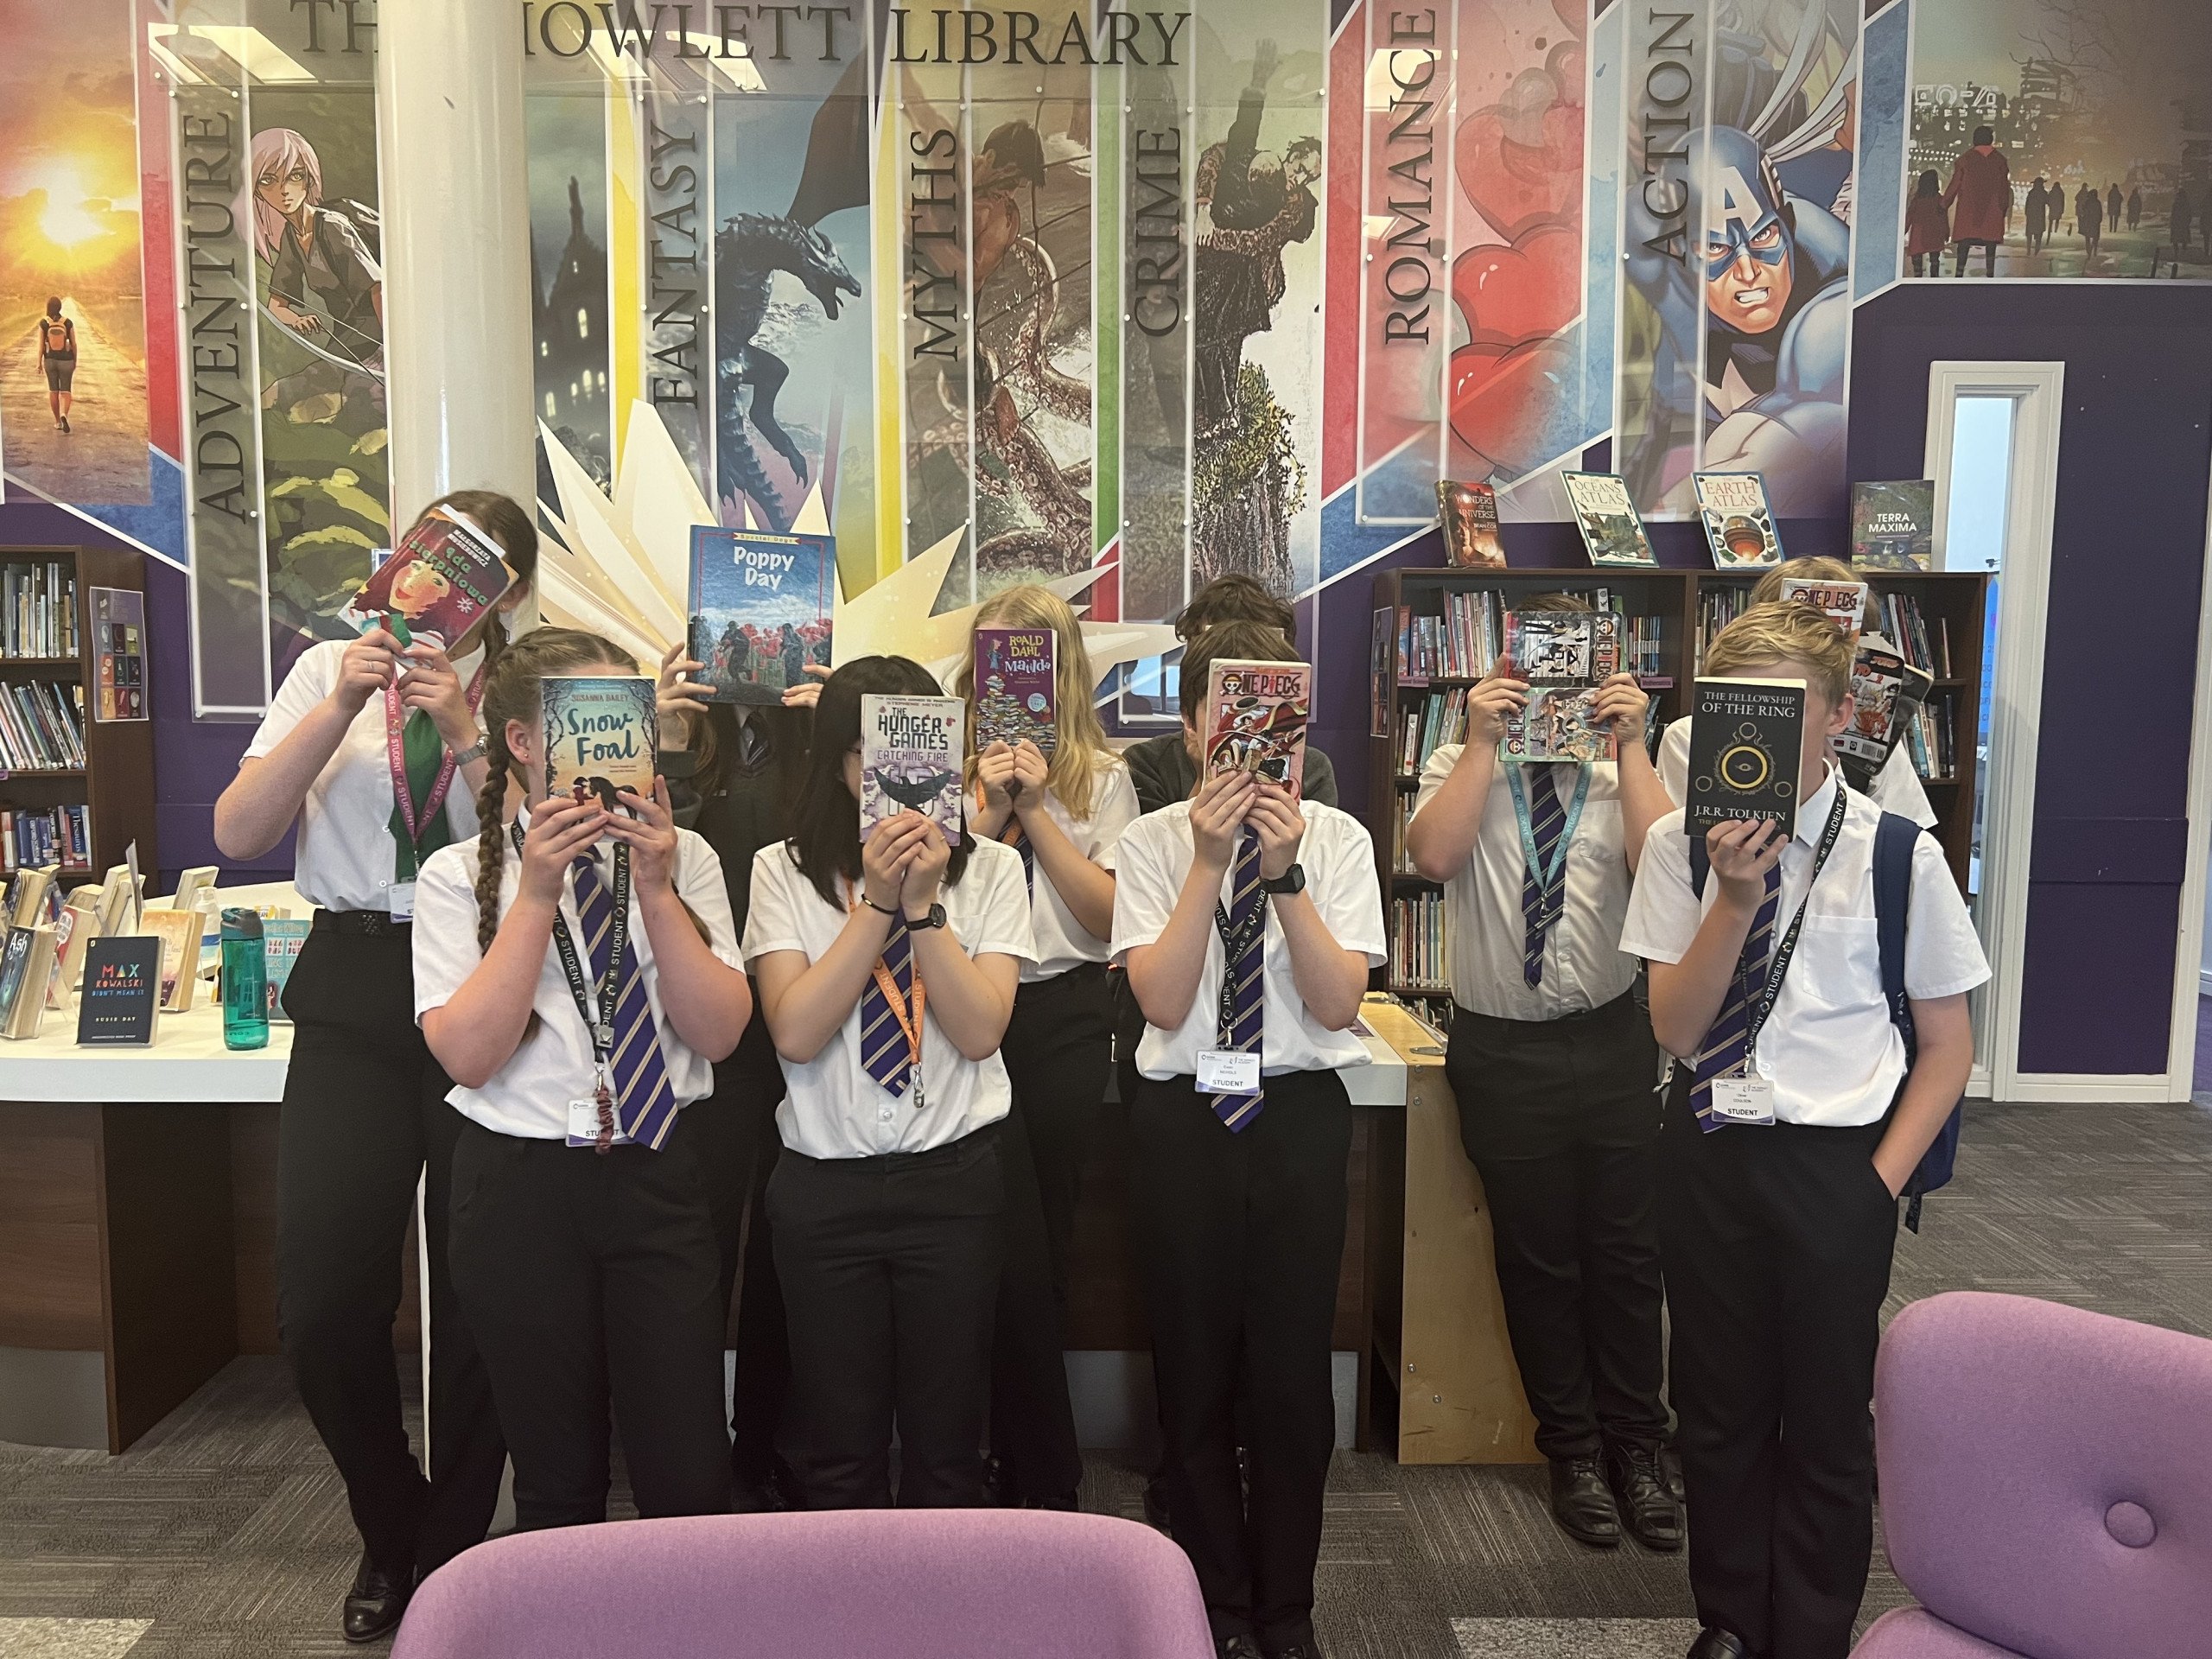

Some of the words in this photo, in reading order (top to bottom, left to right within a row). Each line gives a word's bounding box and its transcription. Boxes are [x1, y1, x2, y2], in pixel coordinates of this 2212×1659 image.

[290, 0, 378, 54] TH
[523, 0, 851, 61] OWLETT
[890, 7, 1192, 67] LIBRARY
[1641, 7, 1695, 268] ACTION
[1385, 8, 1438, 346] ROMANCE
[910, 129, 959, 363] MYTHS
[1134, 127, 1182, 339] CRIME
[650, 122, 699, 409] FANTASY
[182, 110, 246, 520] ADVENTURE
[1455, 493, 1493, 505] WONDERS
[1575, 481, 1621, 493] OCEANS
[1580, 491, 1625, 505] ATLAS
[1705, 482, 1756, 494] EARTH
[1713, 493, 1758, 506] ATLAS
[1459, 508, 1496, 519] UNIVERSE
[1877, 512, 1910, 523] TERRA
[1868, 522, 1917, 533] MAXIMA
[734, 546, 795, 572] Poppy
[745, 567, 783, 593] Day
[1824, 590, 1859, 611] PECE
[1008, 635, 1045, 646] ROALD
[1011, 646, 1041, 658] DAHL
[1004, 658, 1052, 674] Matilda
[571, 694, 605, 702] SUSANNA
[606, 694, 630, 702] BAILEY
[1701, 702, 1722, 713] OF
[1725, 703, 1755, 715] THE
[1758, 706, 1796, 718] RING
[1705, 691, 1726, 701] THE
[1728, 692, 1796, 705] FELLOWSHIP
[567, 708, 633, 735] Snow
[892, 707, 907, 718] THE
[391, 739, 402, 772] STUDENT
[576, 729, 640, 766] Foal
[877, 750, 924, 761] CATCHING
[927, 751, 949, 762] FIRE
[435, 760, 454, 798] STUDENT
[398, 787, 415, 826] STUDENT
[1516, 803, 1530, 836] STUDENT
[1567, 802, 1582, 833] STUDENT
[1727, 808, 1786, 821] TOLKIEN
[73, 815, 81, 853] Thesaurus
[1826, 802, 1845, 845] STUDENT
[617, 868, 627, 906] STUDENT
[7, 931, 29, 960] Ash
[611, 920, 624, 966] STUDENT
[101, 963, 140, 978] MAX
[561, 940, 582, 986] STUDENT
[95, 979, 143, 988] KOWALSKI
[1765, 956, 1788, 1000] STUDENT
[880, 973, 905, 1012] STUDENT
[913, 983, 923, 1028] STUDENT
[601, 1001, 613, 1027] DENT
[1727, 1108, 1758, 1116] STUDENT
